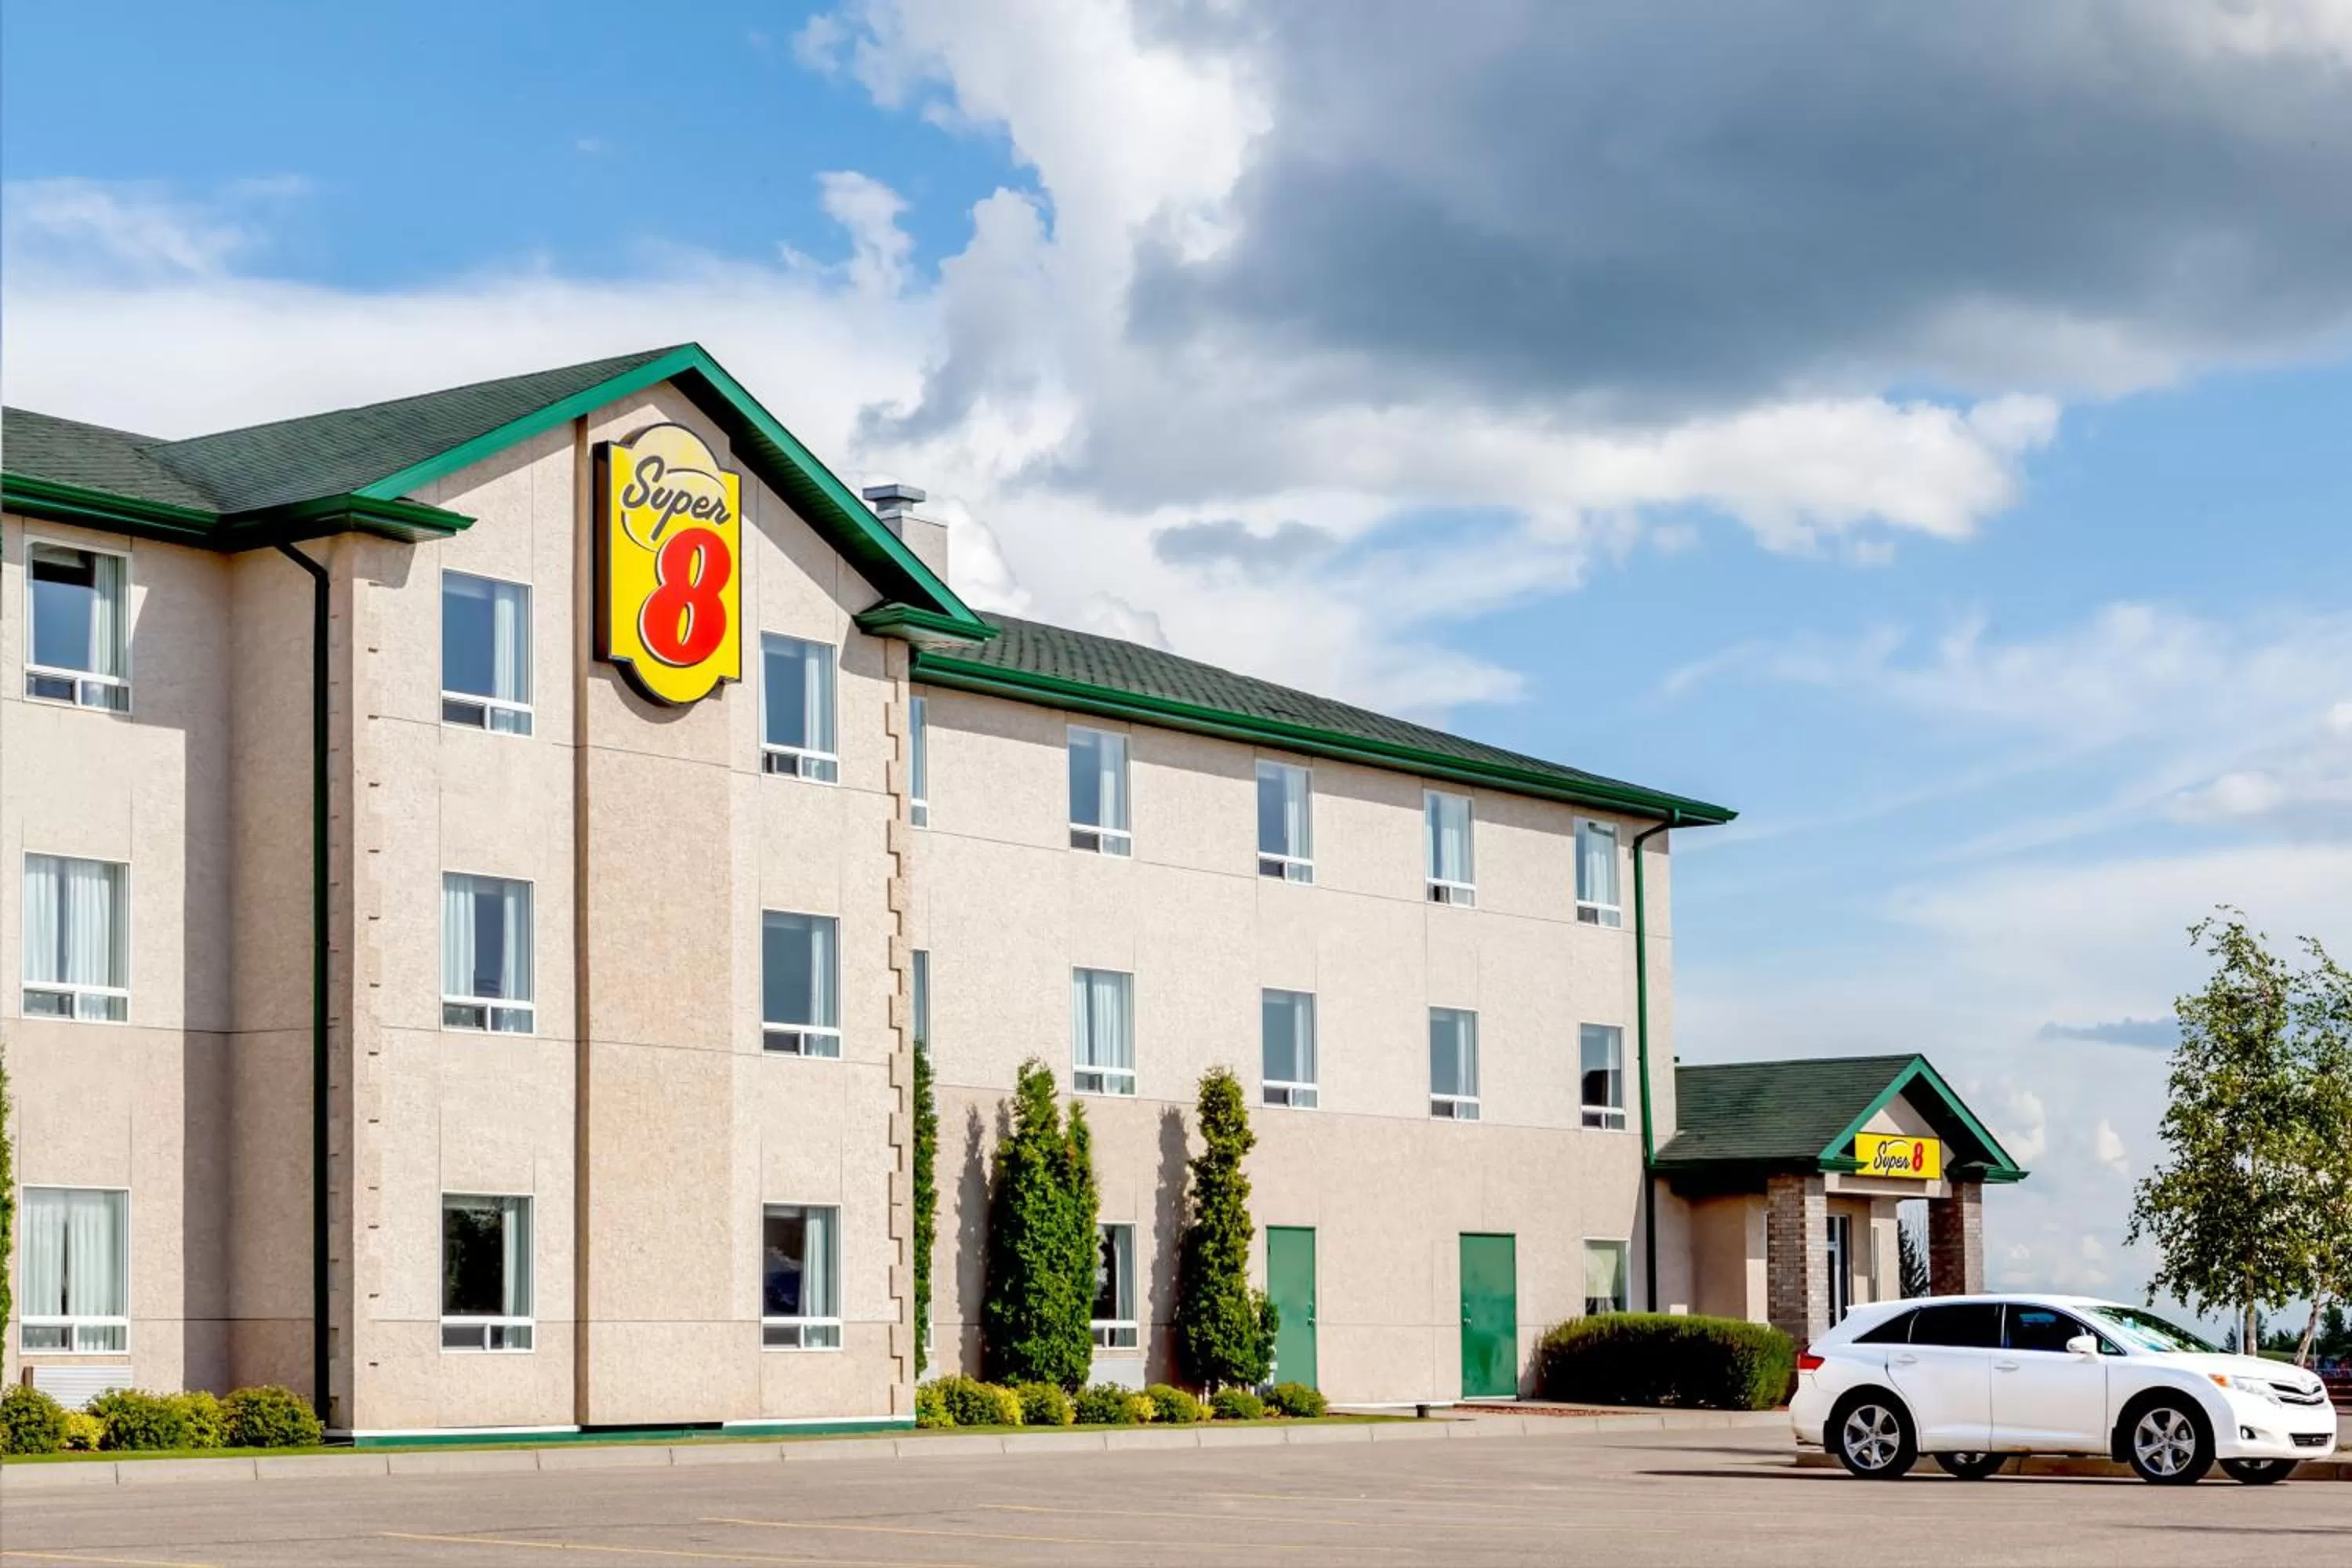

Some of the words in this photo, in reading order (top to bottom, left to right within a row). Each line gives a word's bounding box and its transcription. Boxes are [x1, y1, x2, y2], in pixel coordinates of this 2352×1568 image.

[622, 456, 731, 541] Super
[638, 528, 731, 667] 8
[1874, 1141, 1910, 1176] Super
[1913, 1142, 1924, 1172] 8
